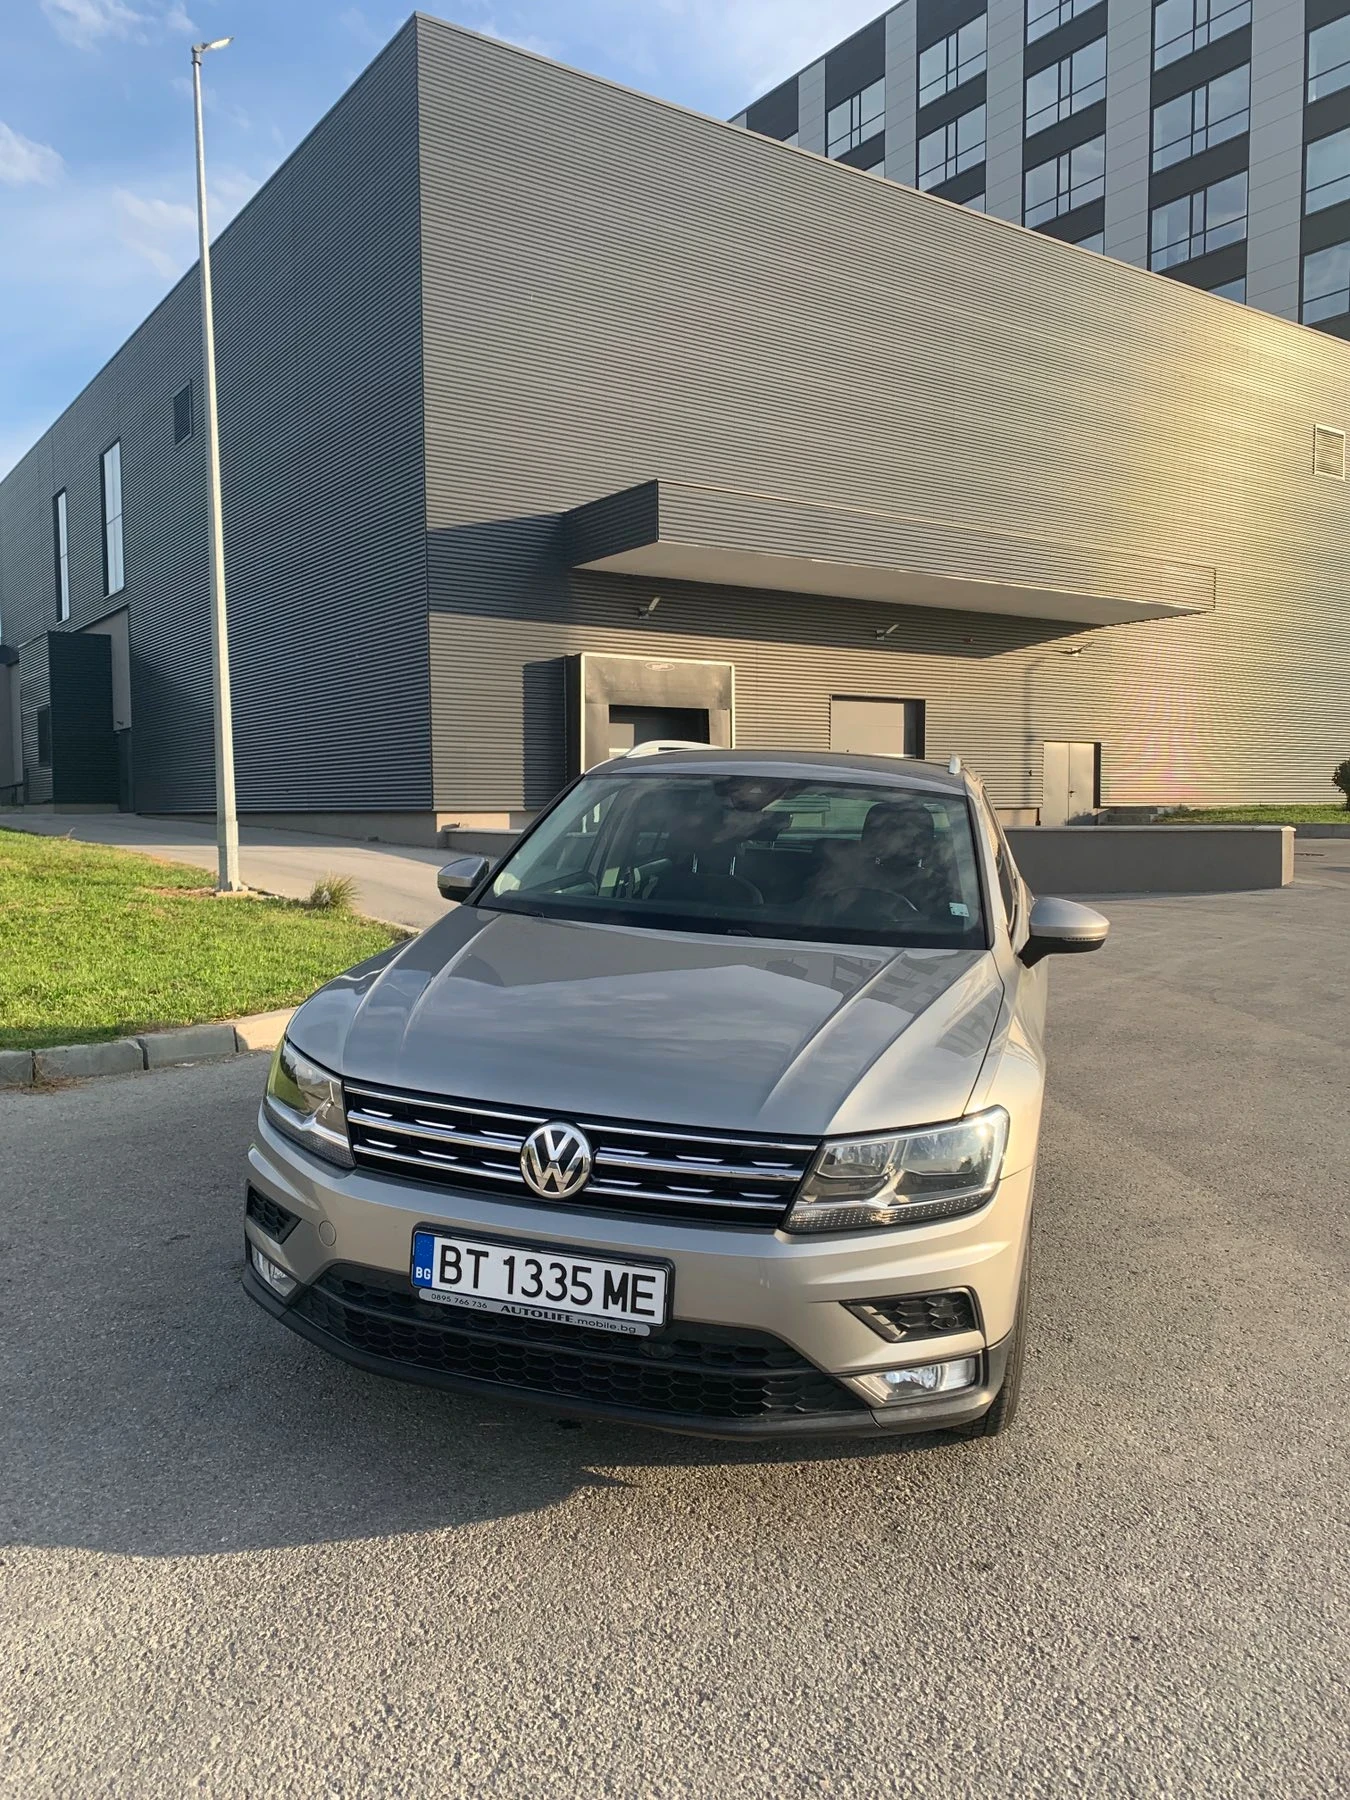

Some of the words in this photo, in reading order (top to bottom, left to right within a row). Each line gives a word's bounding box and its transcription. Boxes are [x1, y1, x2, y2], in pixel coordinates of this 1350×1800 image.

[521, 1122, 591, 1199] VW
[415, 1266, 432, 1280] BG
[439, 1244, 489, 1289] BT
[503, 1255, 593, 1306] 1335
[602, 1269, 656, 1317] ME
[431, 1293, 452, 1303] 0895
[454, 1297, 470, 1306] 766
[472, 1300, 488, 1309] 736
